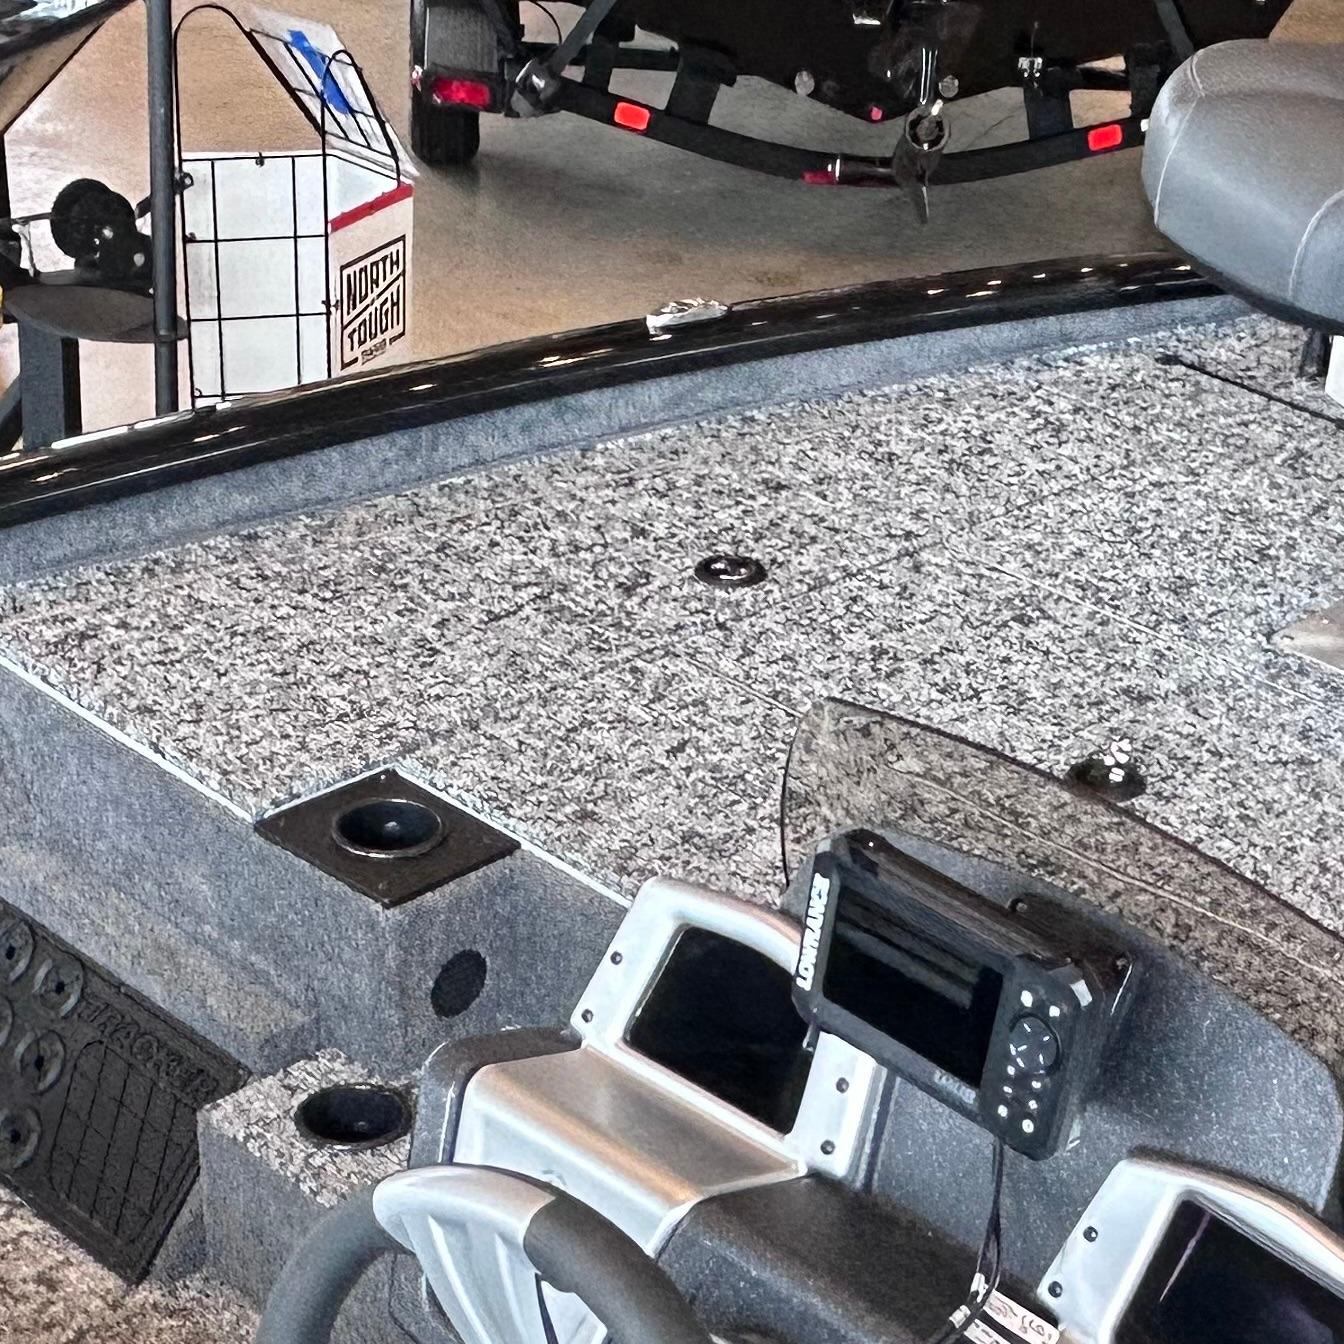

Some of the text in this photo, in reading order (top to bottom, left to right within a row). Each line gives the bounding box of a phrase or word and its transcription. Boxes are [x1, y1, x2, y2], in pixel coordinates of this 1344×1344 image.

[346, 248, 400, 316] NORTH
[347, 284, 400, 352] TOUGH
[795, 872, 831, 992] LOWRANCE
